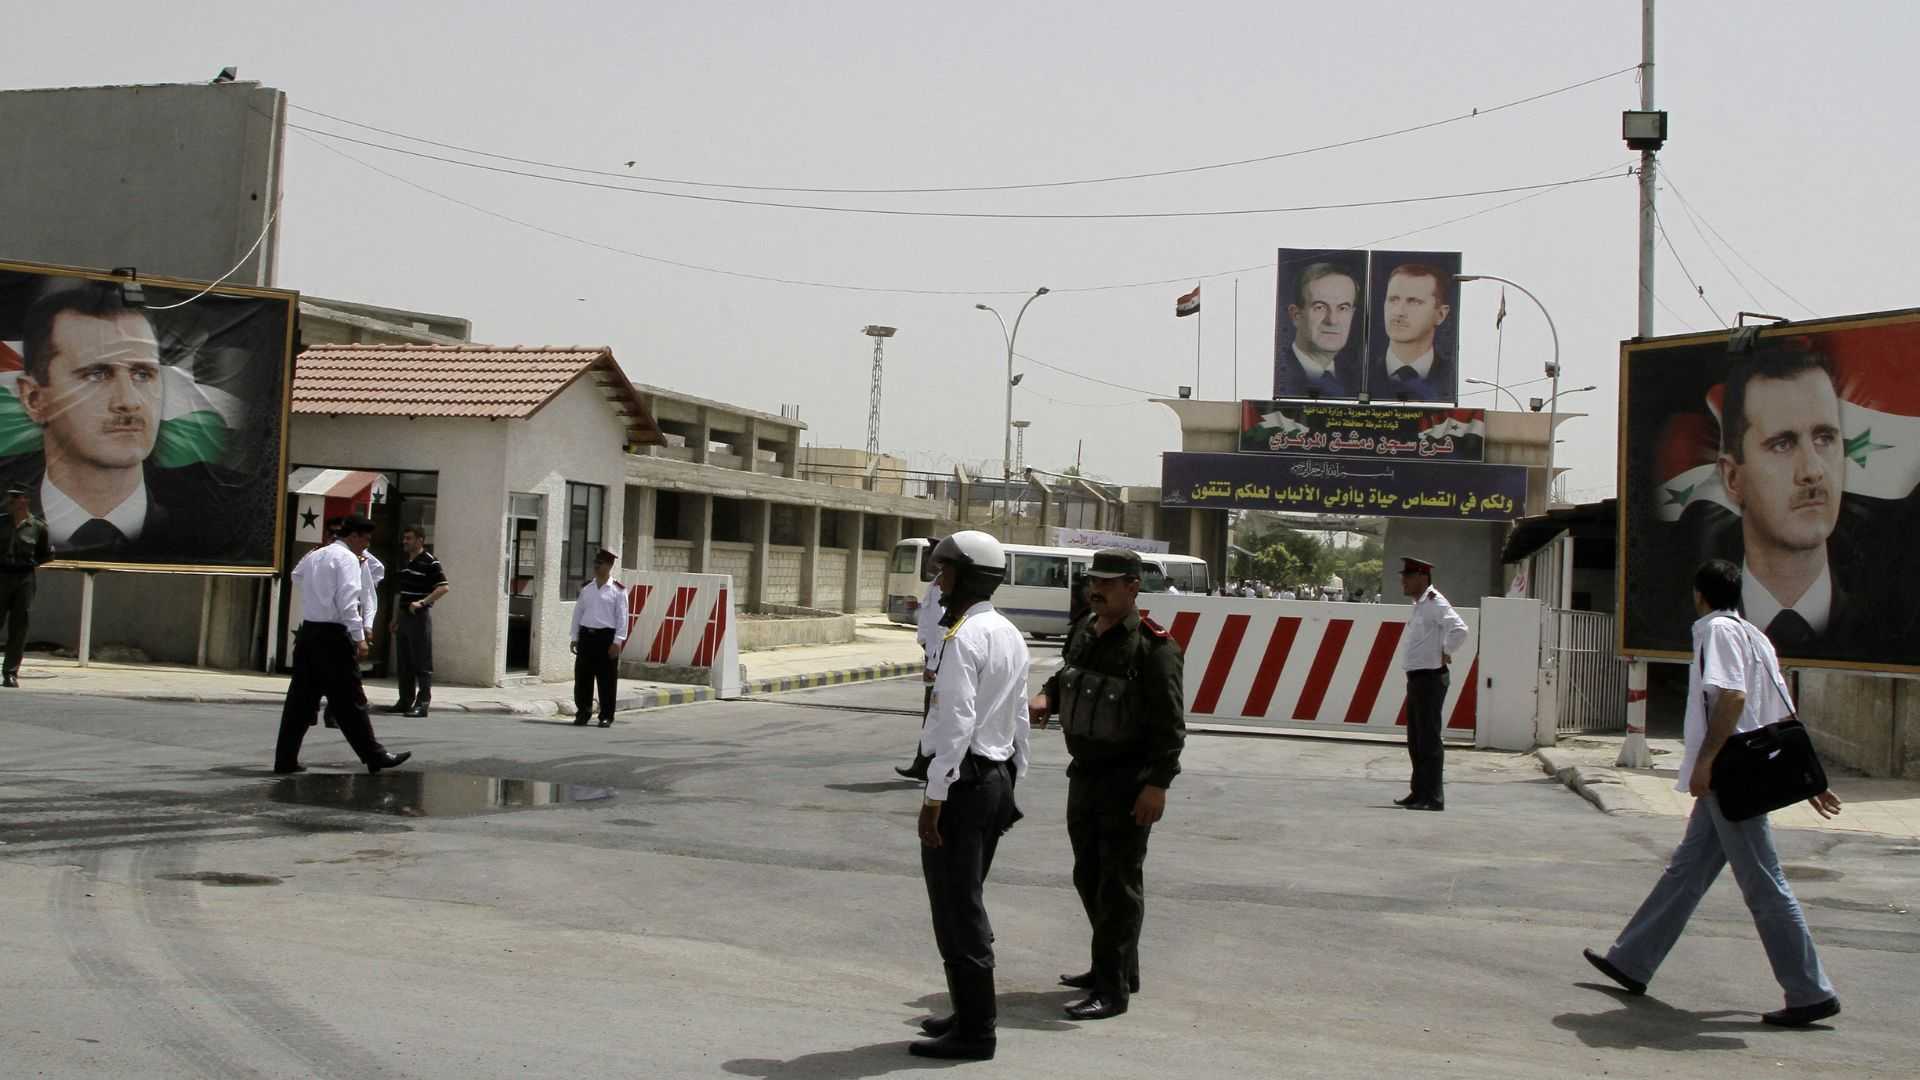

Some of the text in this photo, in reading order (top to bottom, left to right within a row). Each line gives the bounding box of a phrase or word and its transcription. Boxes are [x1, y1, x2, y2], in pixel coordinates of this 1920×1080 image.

[1269, 430, 1455, 456] فرع سجن دمشق المركزي
[1191, 480, 1232, 500] تتقون
[1234, 483, 1270, 502] لعلكم
[1274, 483, 1320, 504] الألباب
[1369, 488, 1398, 508] حياة
[1402, 491, 1456, 509] القصاص
[1460, 491, 1477, 515] في
[1480, 493, 1513, 513] ولكم
